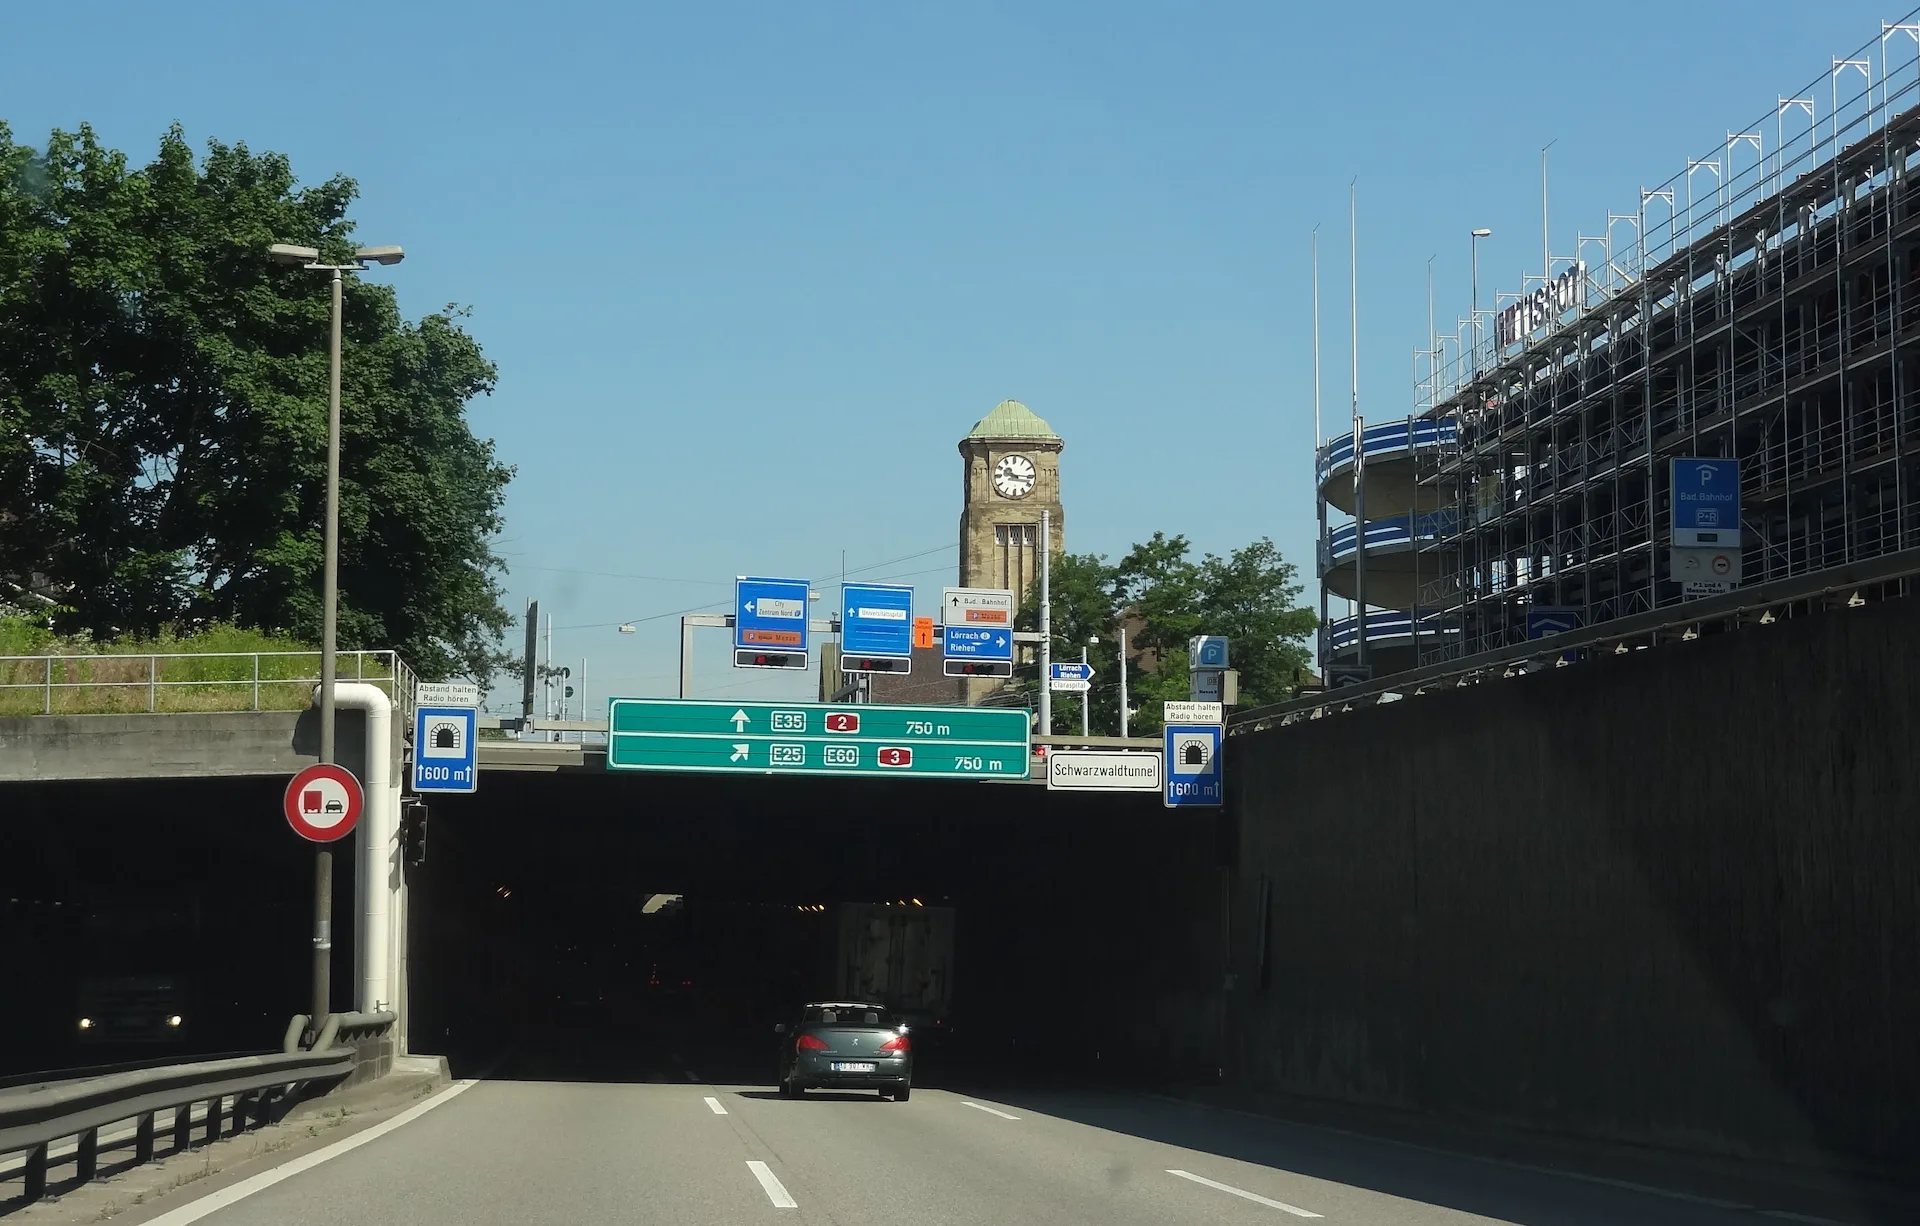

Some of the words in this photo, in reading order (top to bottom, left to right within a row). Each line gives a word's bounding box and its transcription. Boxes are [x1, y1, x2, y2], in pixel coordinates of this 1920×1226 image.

[1701, 470, 1712, 486] P
[1680, 492, 1698, 501] Bad.
[1699, 492, 1733, 501] Bahnhof
[1697, 512, 1717, 522] P+R
[774, 600, 785, 609] City
[981, 598, 1008, 606] Bahnhof
[758, 608, 780, 616] Zentrum
[780, 609, 793, 617] Nord
[950, 643, 976, 652] Riehen
[1208, 648, 1217, 661] P
[1060, 671, 1082, 679] Riehen
[419, 684, 450, 693] Abstand
[452, 685, 477, 694] halten
[1053, 681, 1086, 689] Claraspital
[423, 694, 445, 702] Radio
[447, 695, 469, 703] hören
[1165, 703, 1195, 711] Abstand
[1197, 703, 1221, 711] halten
[1170, 712, 1191, 720] Radio
[774, 714, 803, 729] E35
[837, 716, 848, 730] 2
[906, 721, 933, 736] 750
[937, 724, 950, 736] m
[773, 747, 802, 762] E25
[826, 749, 856, 763] E60
[890, 750, 900, 764] 3
[954, 756, 983, 771] 750
[989, 760, 1002, 771] m
[424, 766, 449, 781] 600
[453, 769, 464, 781] m
[1054, 763, 1156, 778] Schwarzwaldtunnel
[1175, 782, 1199, 796] 600
[1203, 786, 1213, 796] m
